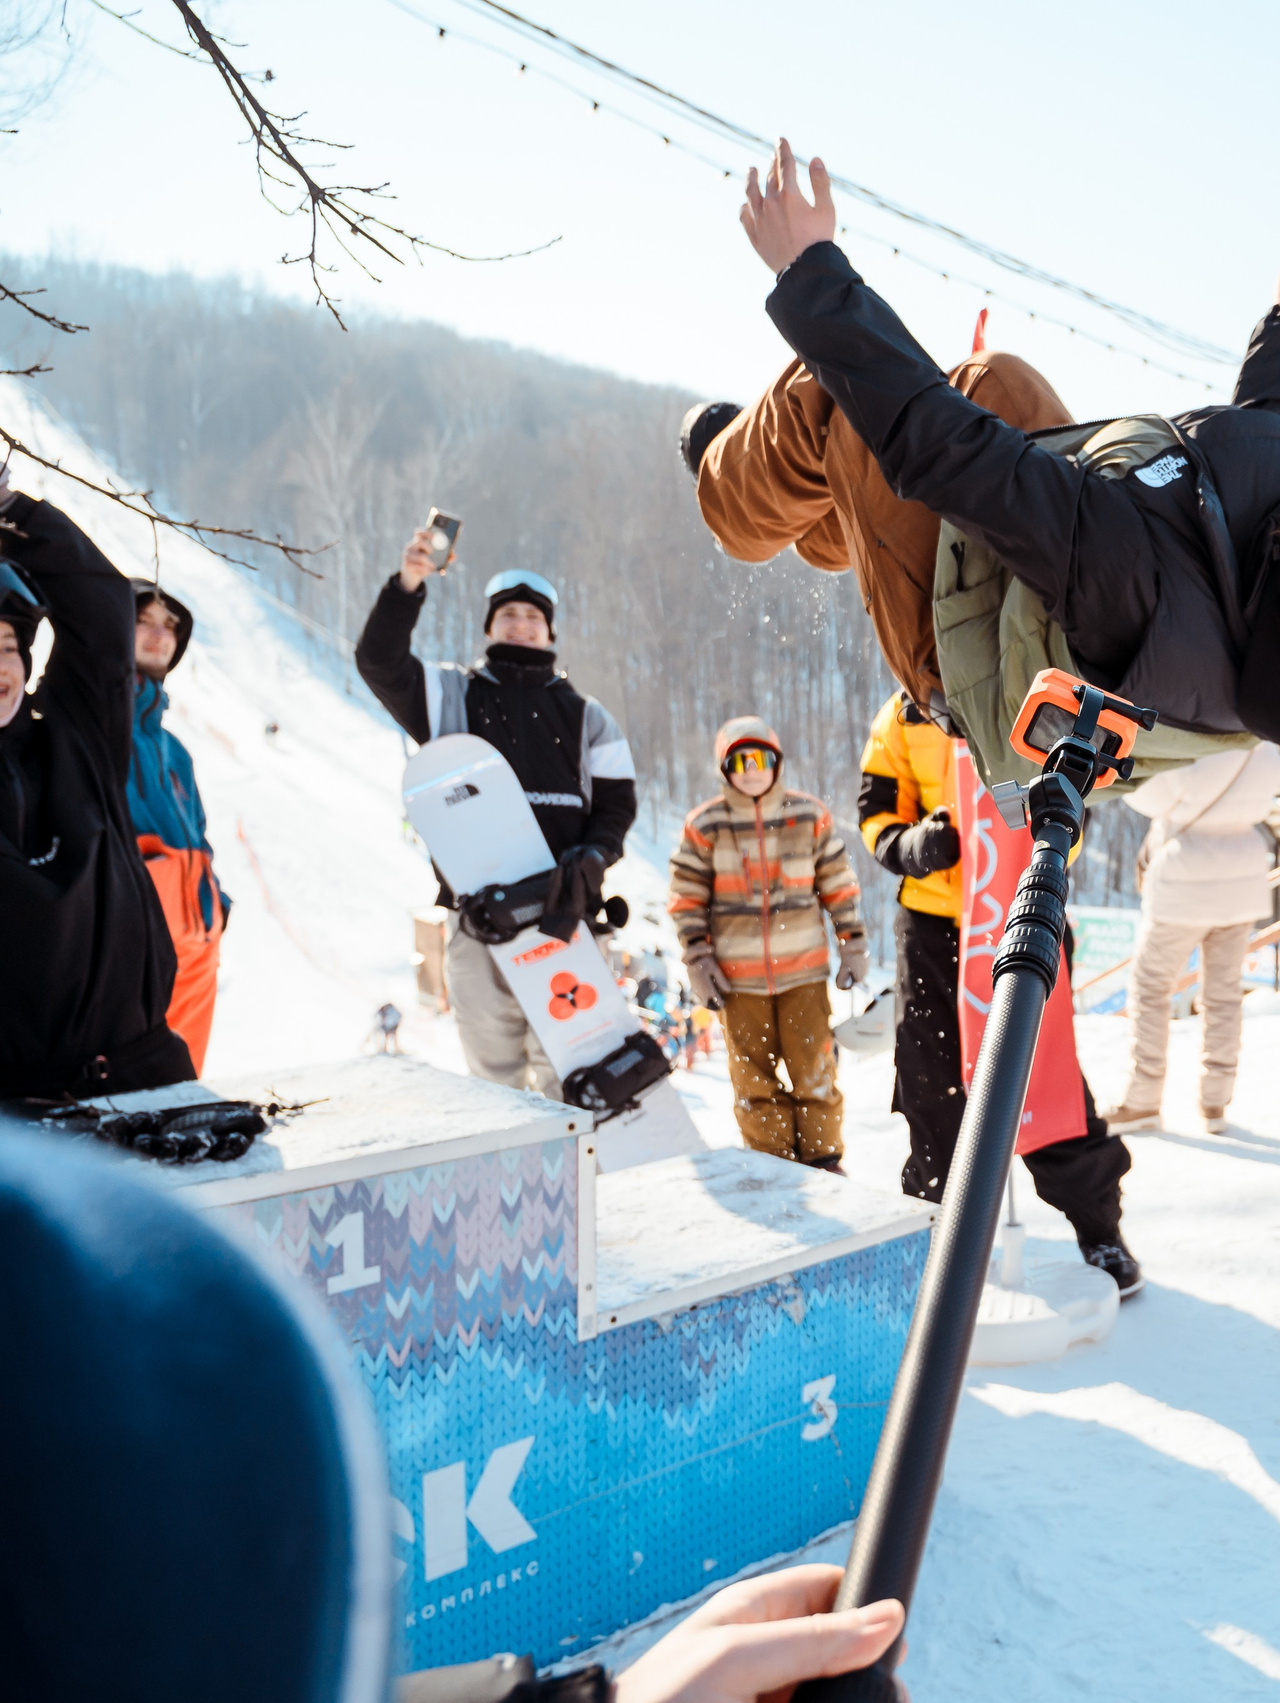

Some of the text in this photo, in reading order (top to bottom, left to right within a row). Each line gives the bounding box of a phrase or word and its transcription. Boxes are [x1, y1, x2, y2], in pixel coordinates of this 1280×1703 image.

[1155, 456, 1189, 478] NORTH
[1160, 469, 1183, 485] THE
[323, 1211, 381, 1296] 1
[801, 1373, 838, 1441] 3
[405, 1560, 540, 1629] КОМПЛЕКС
